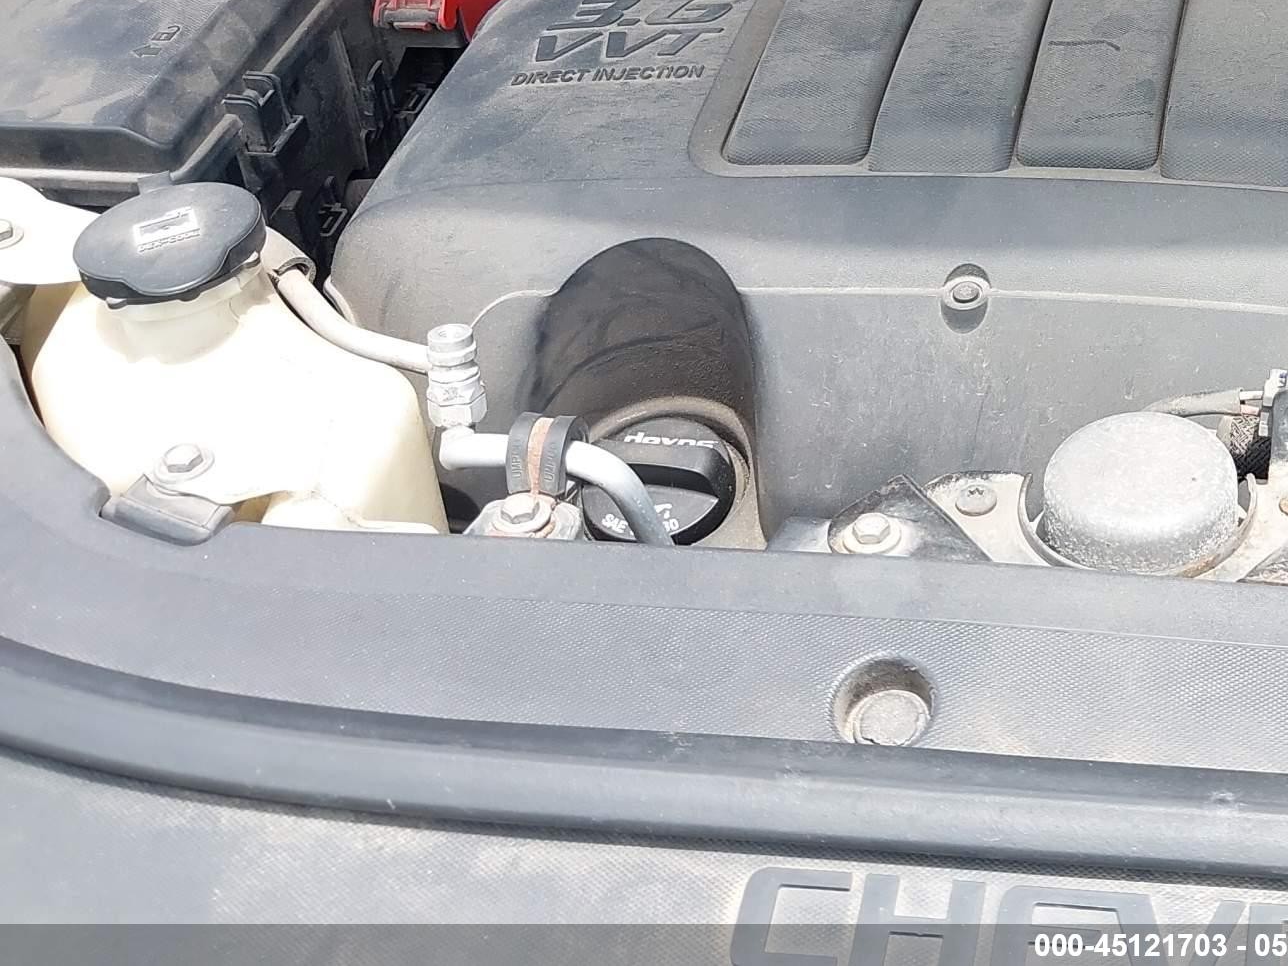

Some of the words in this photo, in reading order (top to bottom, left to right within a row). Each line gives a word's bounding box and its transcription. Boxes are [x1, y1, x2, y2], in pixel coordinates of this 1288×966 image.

[535, 27, 725, 63] VVT
[511, 68, 590, 86] DIRECT
[592, 64, 705, 83] INJECTION
[601, 513, 629, 534] SAE
